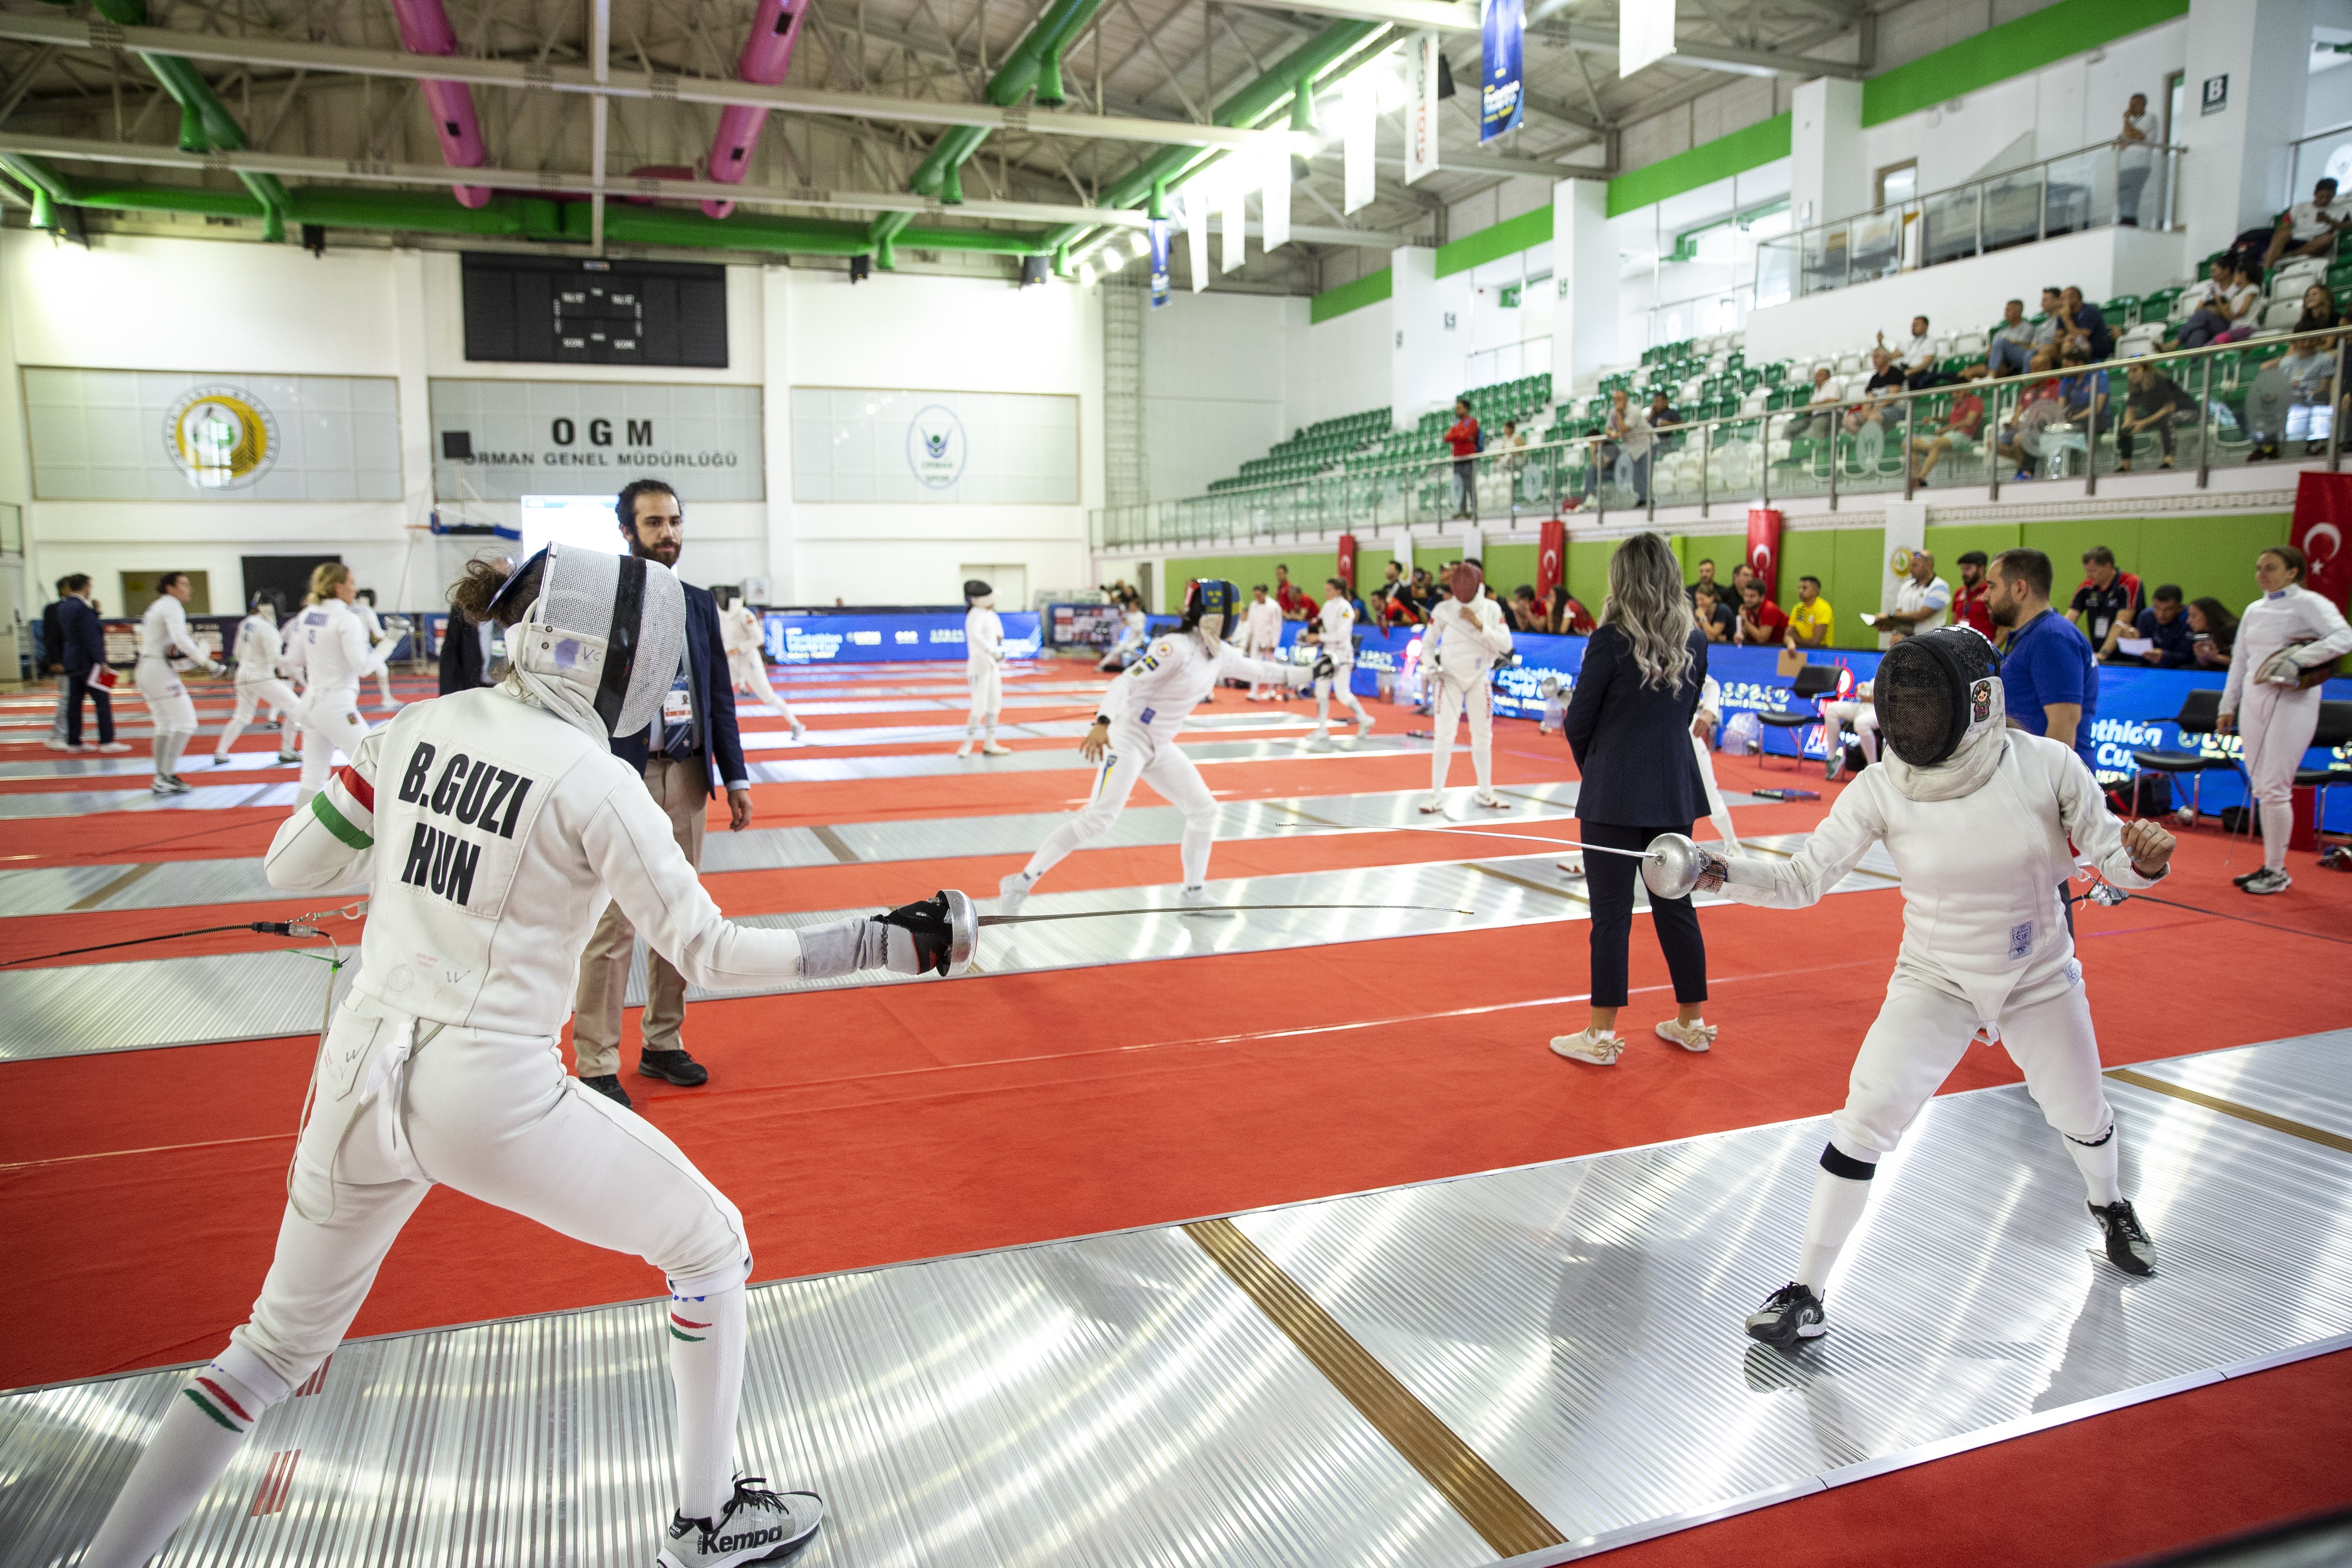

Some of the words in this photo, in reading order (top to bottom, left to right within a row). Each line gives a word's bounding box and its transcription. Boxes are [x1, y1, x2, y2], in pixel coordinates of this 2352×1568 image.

[2207, 78, 2224, 100] B
[544, 453, 608, 467] GENEL
[617, 452, 738, 468] MÜDÜRLÜĞÜ
[398, 741, 534, 839] B.GUZI
[401, 822, 481, 906] HUN
[701, 1525, 783, 1555] Kempa
